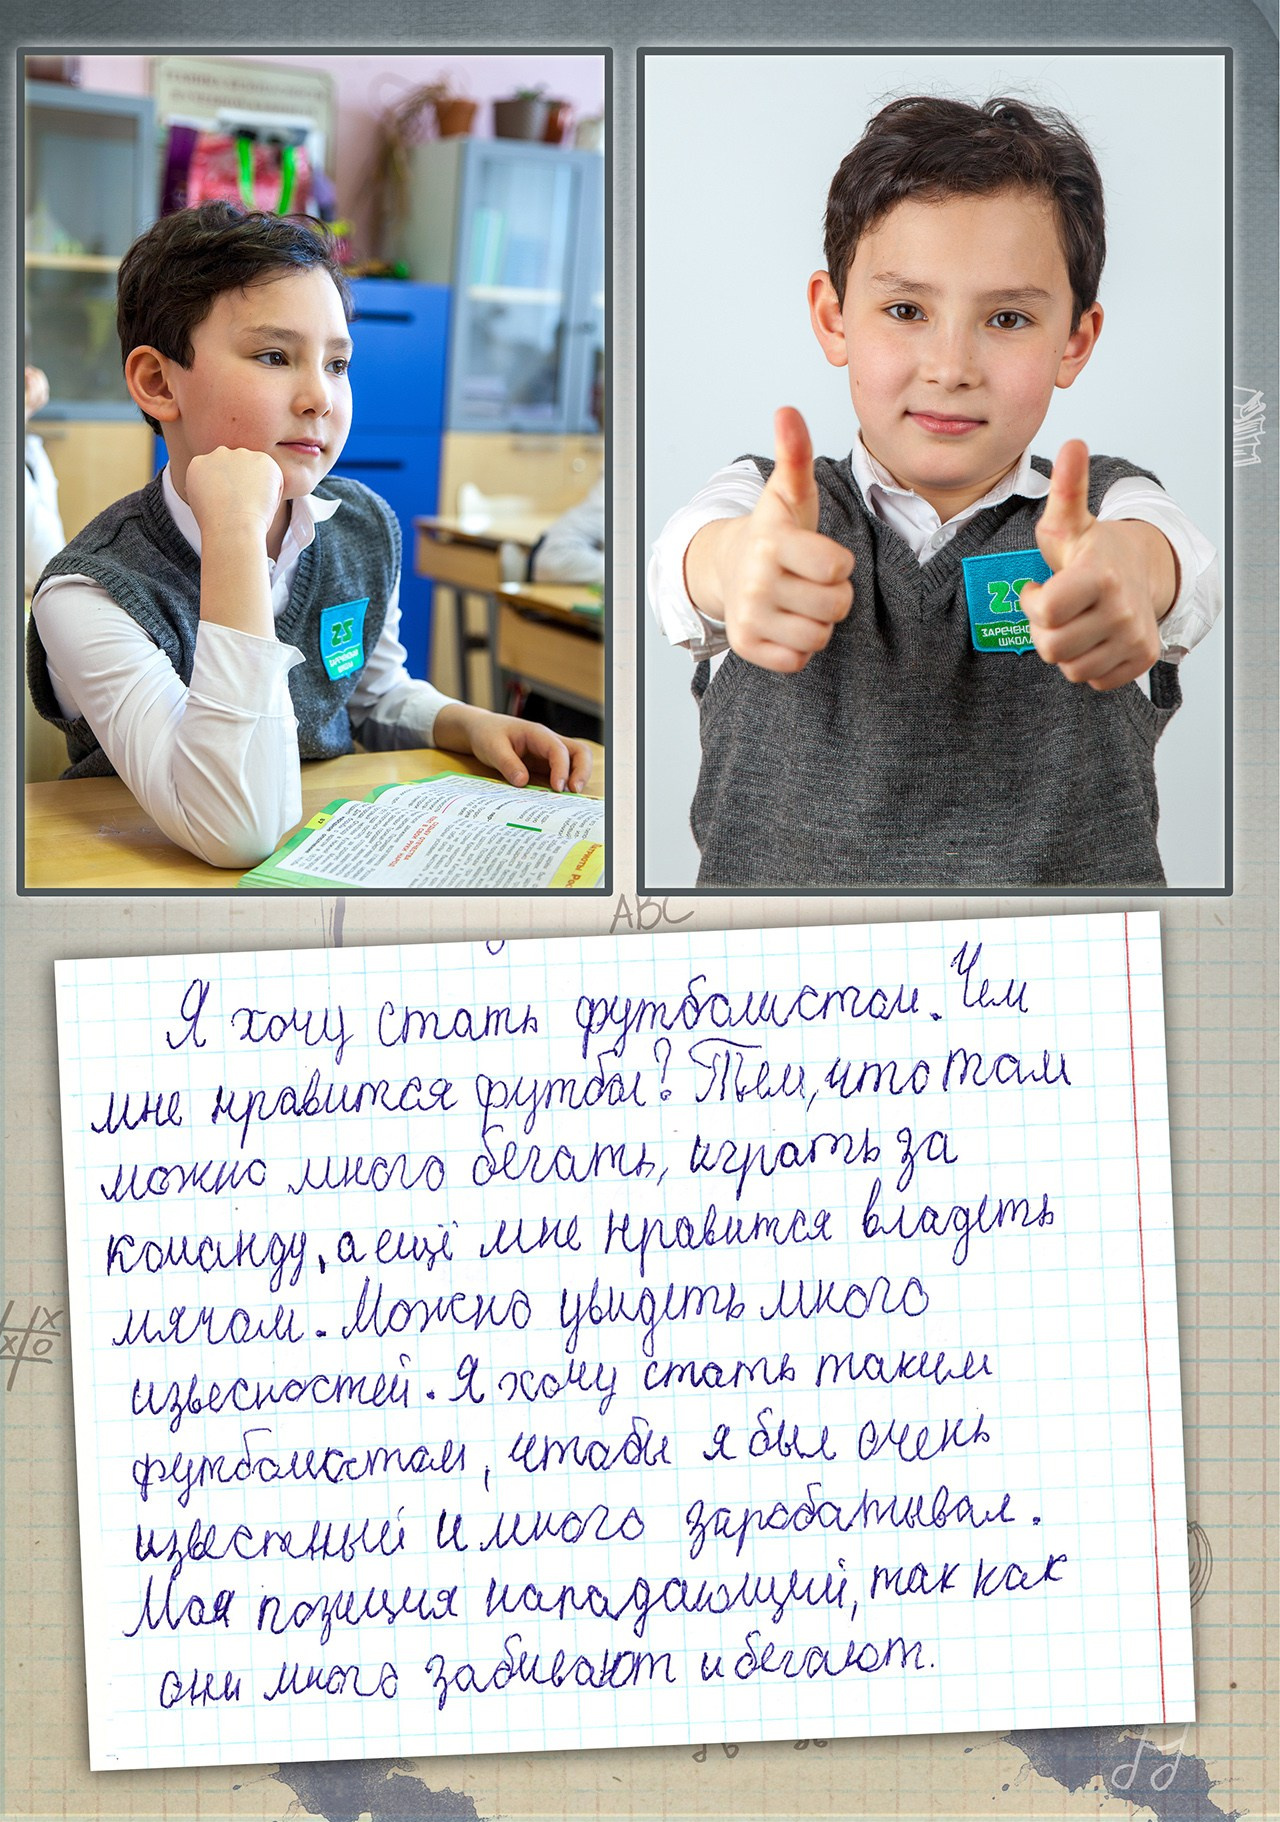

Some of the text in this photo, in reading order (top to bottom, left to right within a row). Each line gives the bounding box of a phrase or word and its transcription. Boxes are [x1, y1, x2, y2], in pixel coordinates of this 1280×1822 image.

[166, 941, 1028, 1065] Я хочу стать футболистом. Чем
[91, 1091, 182, 1134] мне
[212, 1068, 457, 1149] нравится
[477, 1037, 673, 1136] футбол?
[825, 1057, 929, 1098] что
[942, 1048, 1071, 1092] там
[101, 1125, 958, 1202] можно много бегать, играть за
[107, 1230, 326, 1293] команду,
[338, 1231, 367, 1263] а
[480, 1215, 581, 1258] мне
[605, 1204, 832, 1278] нравится
[112, 1305, 326, 1346] мячом.
[342, 1276, 531, 1340] Можно
[760, 1276, 929, 1320] много
[449, 1354, 484, 1403] Я
[498, 1359, 616, 1415] хочу
[644, 1353, 795, 1390] стать
[815, 1351, 992, 1387] таким
[703, 1424, 736, 1461] я
[749, 1407, 836, 1460] был
[858, 1414, 990, 1462] очень
[437, 1509, 468, 1551] и
[480, 1504, 644, 1551] много
[123, 1553, 1068, 1645] Моя позиция нападающий, так как
[160, 1631, 935, 1711] они много забивают и бегают.
